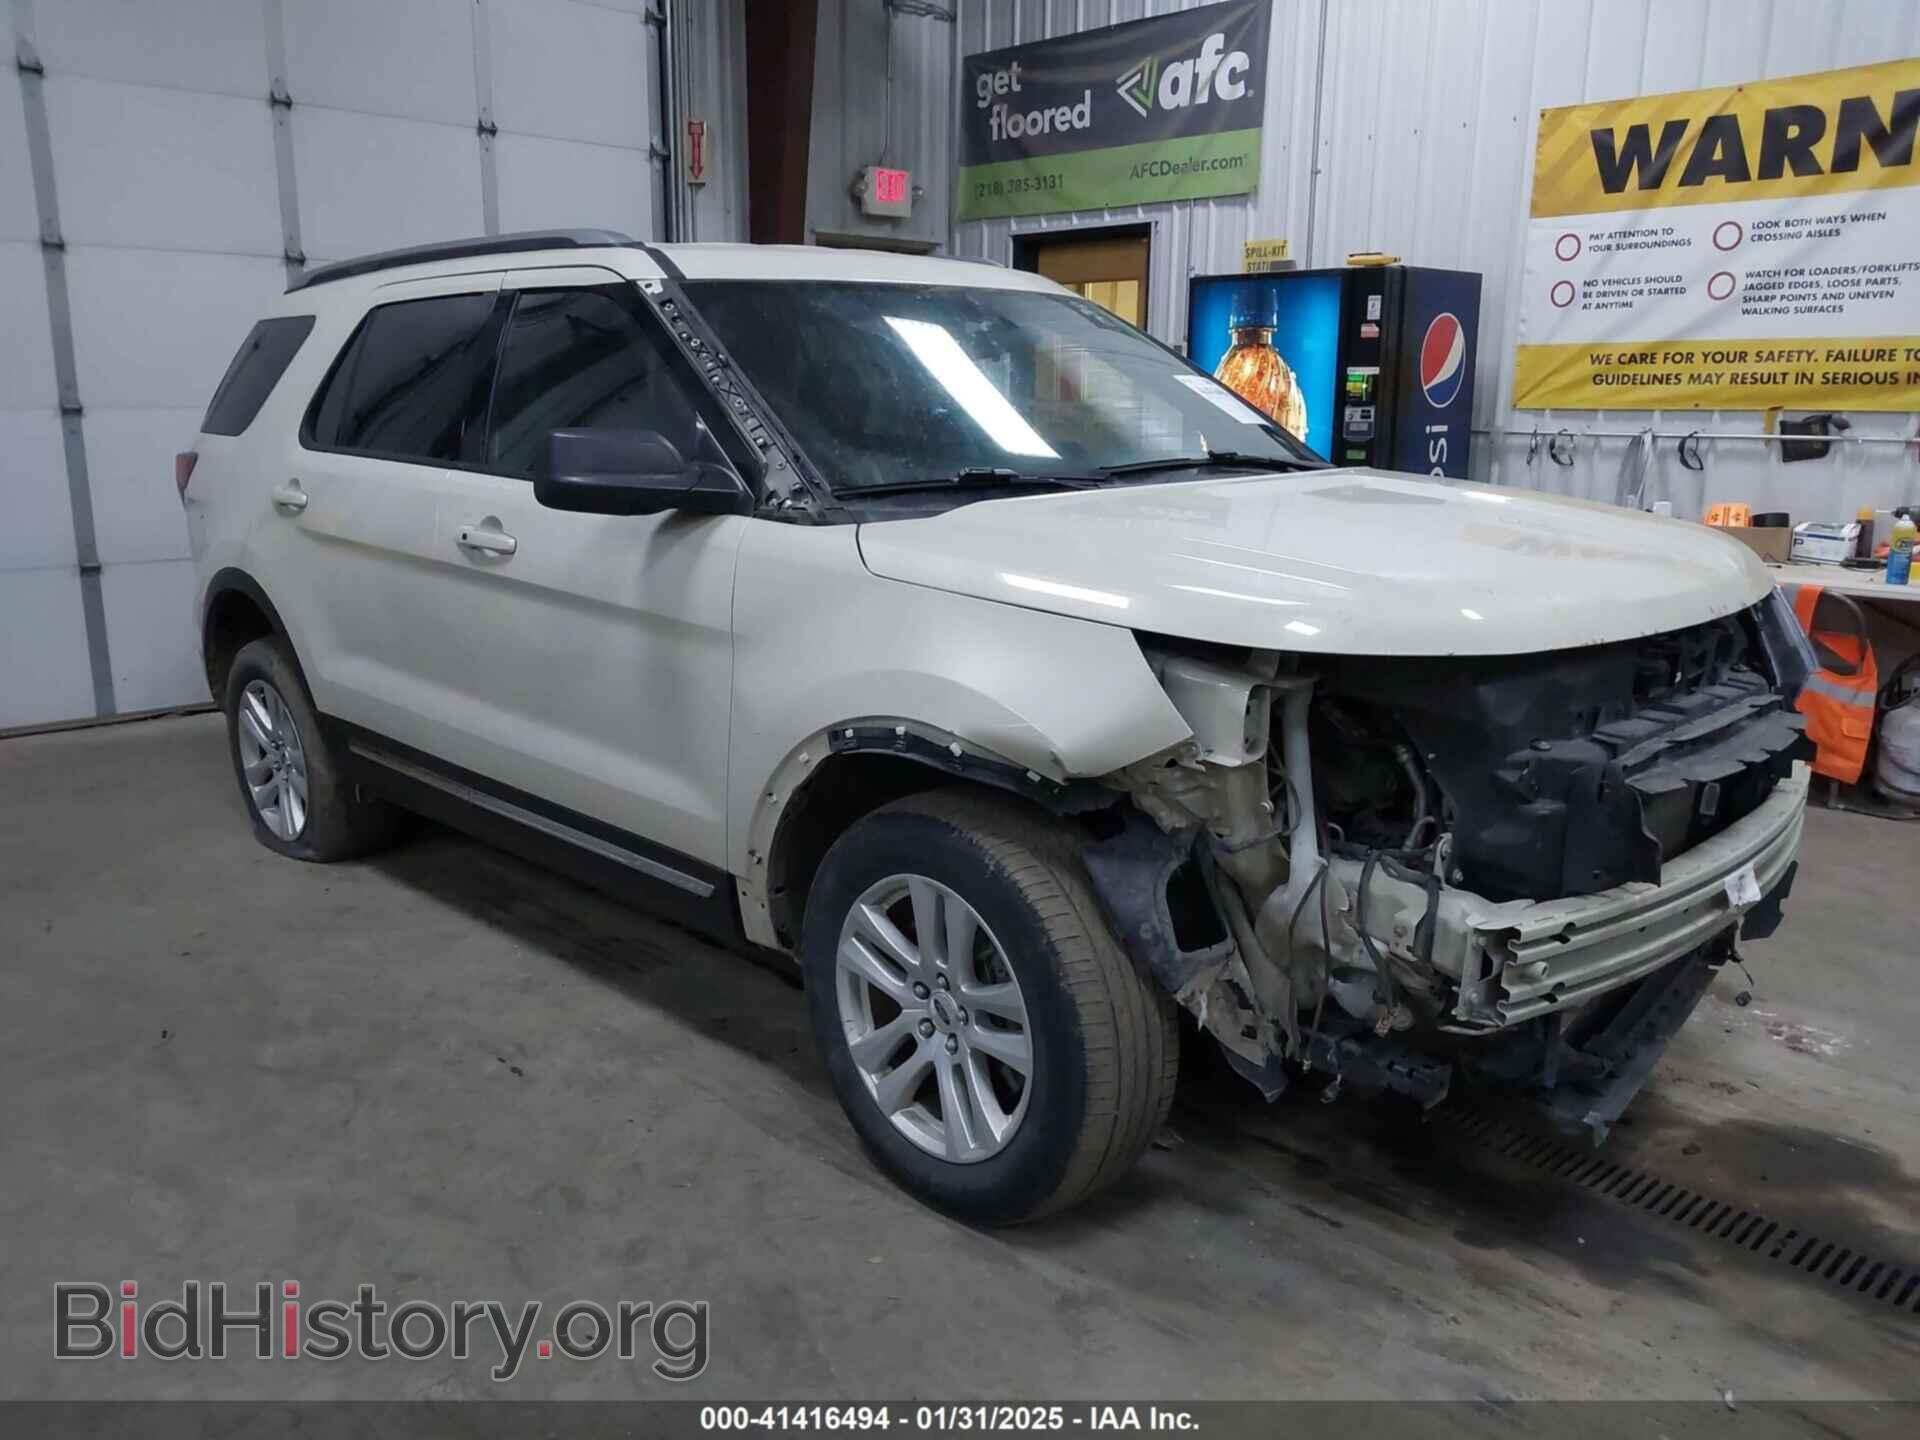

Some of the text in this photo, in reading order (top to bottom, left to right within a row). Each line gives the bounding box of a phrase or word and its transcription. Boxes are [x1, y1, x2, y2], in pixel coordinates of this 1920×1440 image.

[977, 61, 1022, 108] get
[989, 89, 1091, 141] floored
[1590, 88, 1920, 194] WARN
[1752, 212, 1887, 230] LOOK BOTH WAYS WHEN
[1589, 226, 1674, 241] PAY ATTENTION TO
[1751, 228, 1841, 243] CROSSING AISLES
[1588, 237, 1692, 253] YOUR SURROUNDINGS
[1583, 275, 1682, 287] NO VEHICLES SHOULD
[1745, 269, 1781, 279] WATCH
[1785, 268, 1805, 277] FOR
[1582, 286, 1687, 299] BE DRIVEN OR STARTED
[1744, 282, 1784, 292] JAGGED
[1827, 279, 1861, 288] LOOSE
[1743, 290, 1894, 304] SHARP POINTS AND UNEVEN
[1582, 300, 1633, 310] AT ANYTIME
[1741, 304, 1845, 316] WALKING SURFACES
[1590, 353, 1613, 366] WE
[1617, 352, 1658, 365] CARE
[1663, 351, 1695, 364] FOR
[1701, 351, 1748, 364] YOUR
[1754, 350, 1818, 363] SAFETY.
[1825, 348, 1897, 362] FAILURE
[1592, 373, 1682, 386] GUIDELINES
[1687, 372, 1724, 385] MAY
[1729, 372, 1788, 385] RESULT
[1794, 372, 1814, 385] IN
[1821, 371, 1899, 385] SERIOUS
